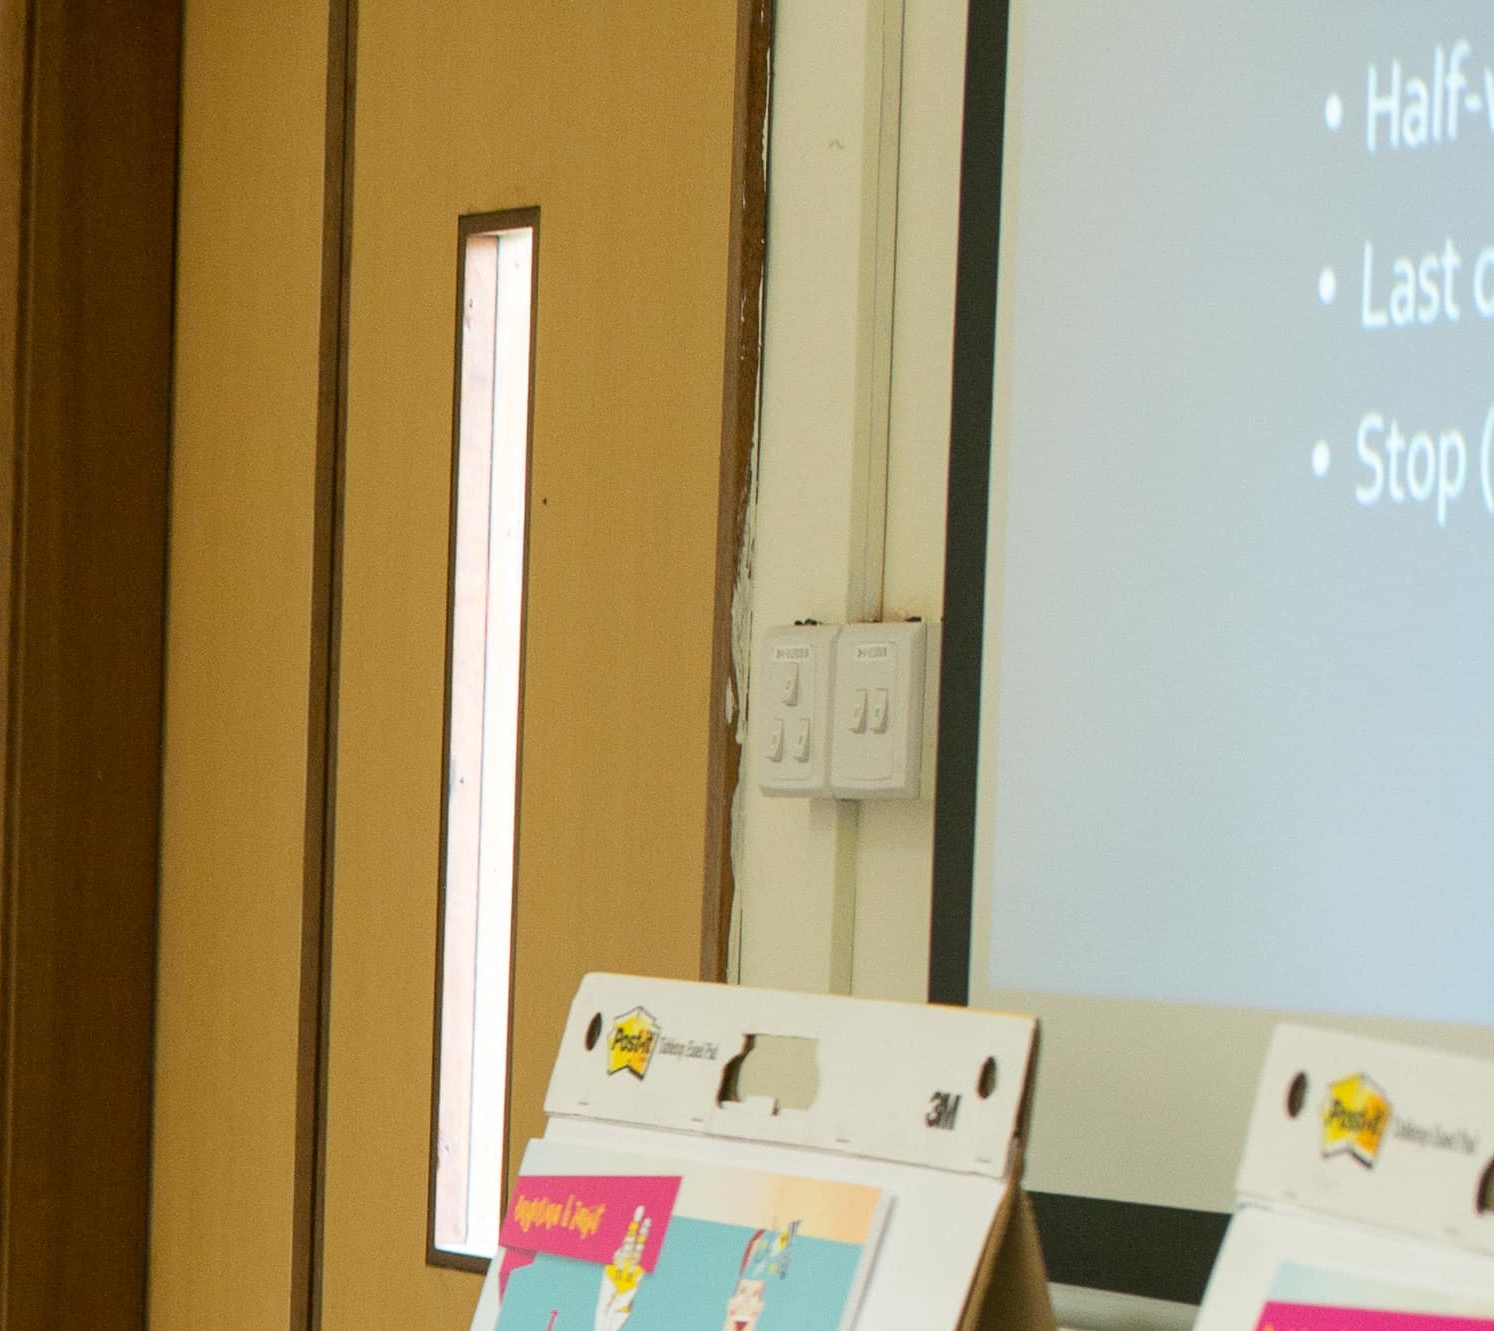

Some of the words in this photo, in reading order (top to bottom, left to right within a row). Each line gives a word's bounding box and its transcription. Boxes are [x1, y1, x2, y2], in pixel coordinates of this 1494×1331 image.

[1362, 241, 1461, 330] Last
[1356, 412, 1467, 528] Stop
[925, 1092, 963, 1130] 3M
